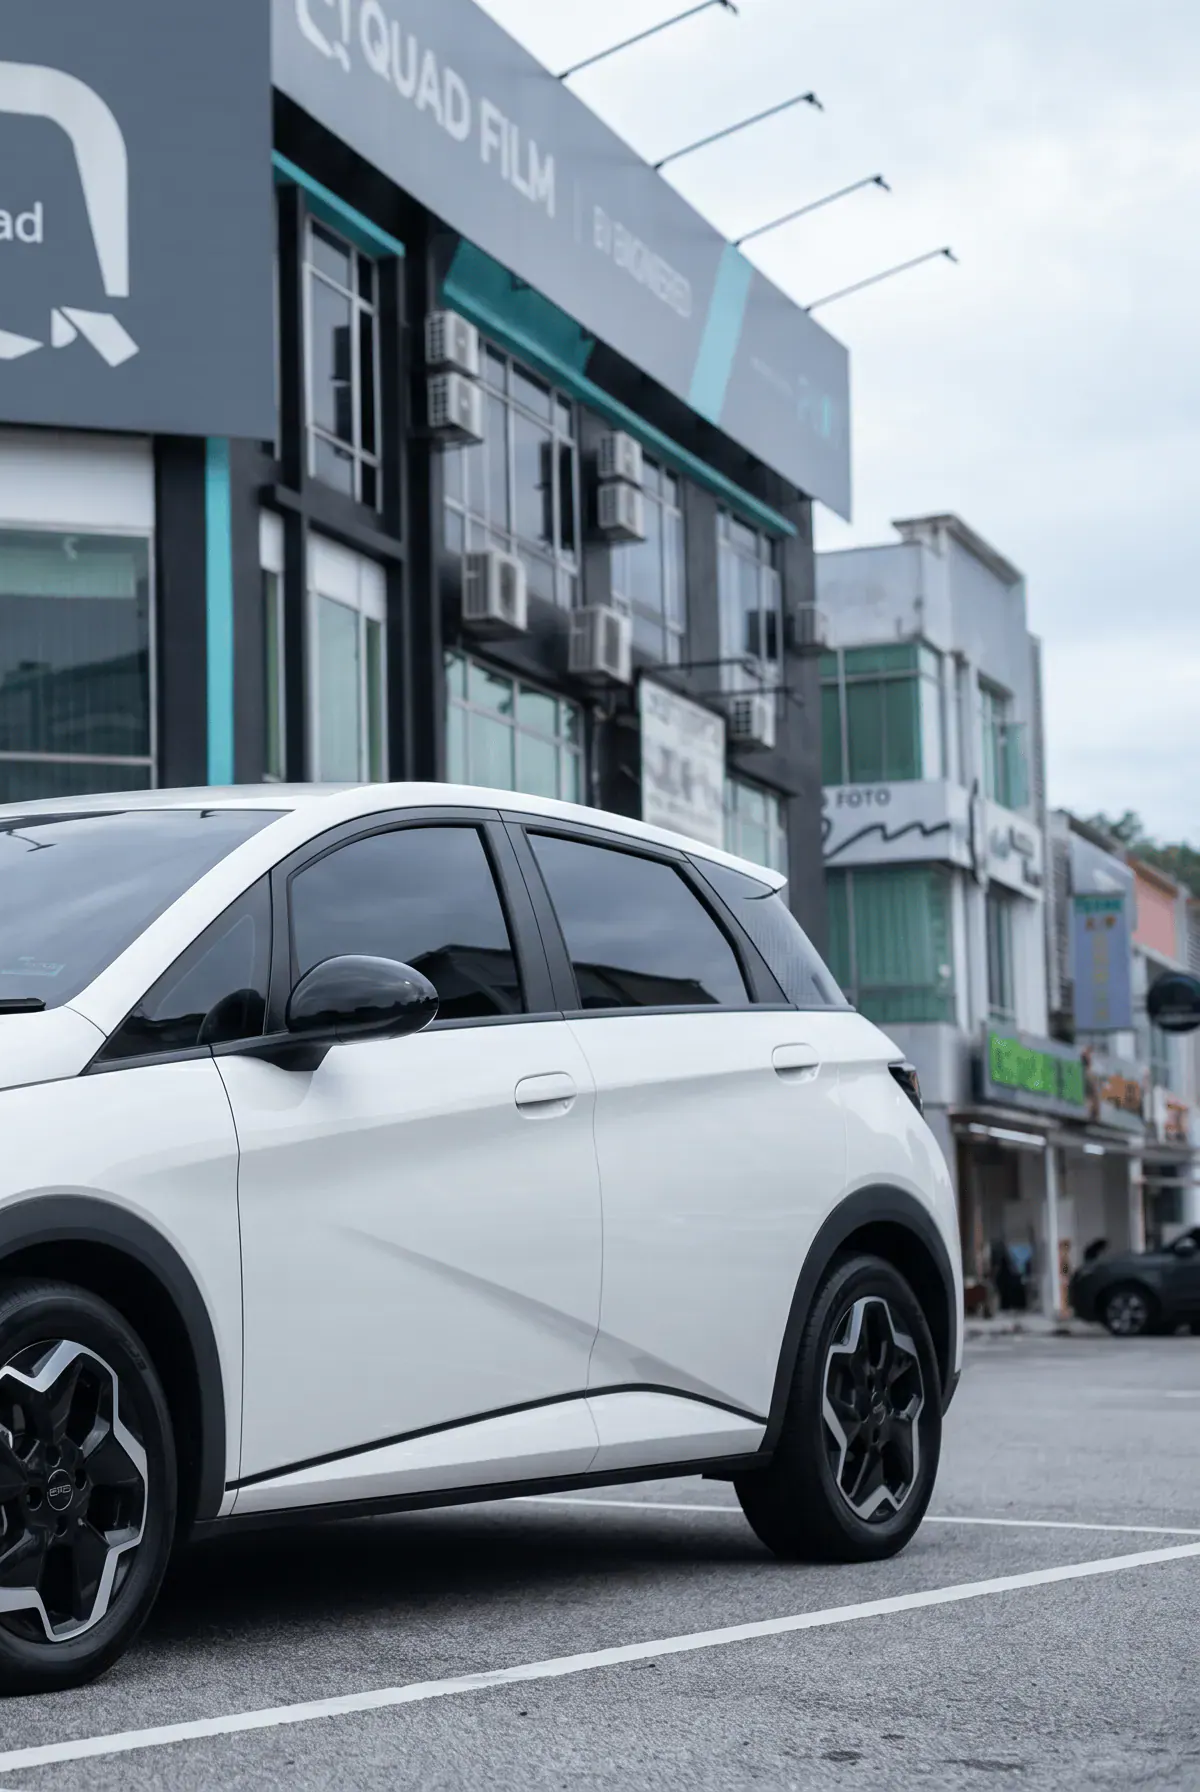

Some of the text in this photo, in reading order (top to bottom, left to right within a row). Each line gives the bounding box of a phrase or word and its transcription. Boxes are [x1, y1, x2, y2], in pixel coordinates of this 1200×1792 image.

[359, 0, 555, 219] QUAD FILM
[835, 787, 892, 809] FOTO
